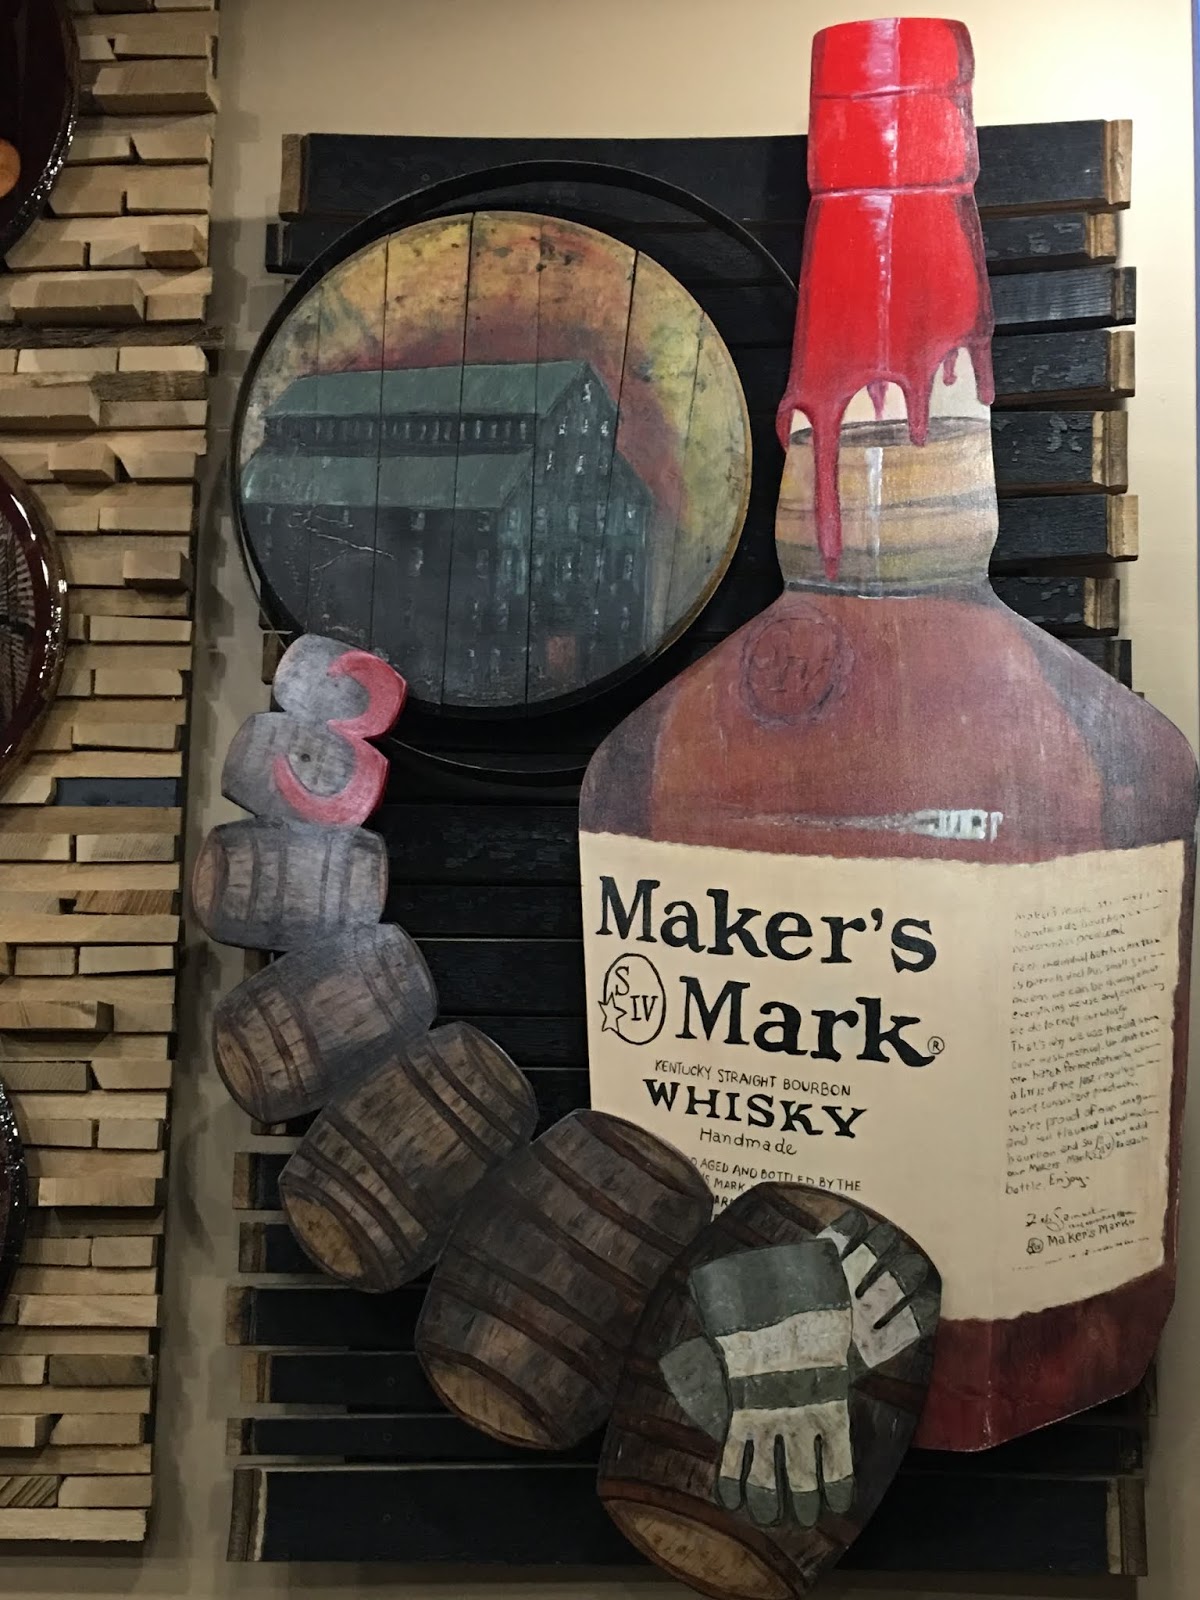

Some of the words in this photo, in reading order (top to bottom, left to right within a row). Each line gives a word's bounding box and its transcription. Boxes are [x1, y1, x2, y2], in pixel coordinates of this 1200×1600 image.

[595, 875, 937, 973] Maker's
[614, 965, 630, 996] S
[629, 995, 659, 1022] IV
[655, 1058, 713, 1081] KENTUCKY
[718, 1068, 777, 1089] STRAIGHT
[782, 1078, 851, 1097] BOURBON
[642, 1078, 867, 1139] WHISKY
[699, 1127, 798, 1156] Handmade
[700, 1158, 729, 1173] AGED
[732, 1164, 758, 1179] AND
[819, 1176, 834, 1189] BY
[836, 1178, 861, 1191] THE
[713, 1177, 746, 1192] MARK
